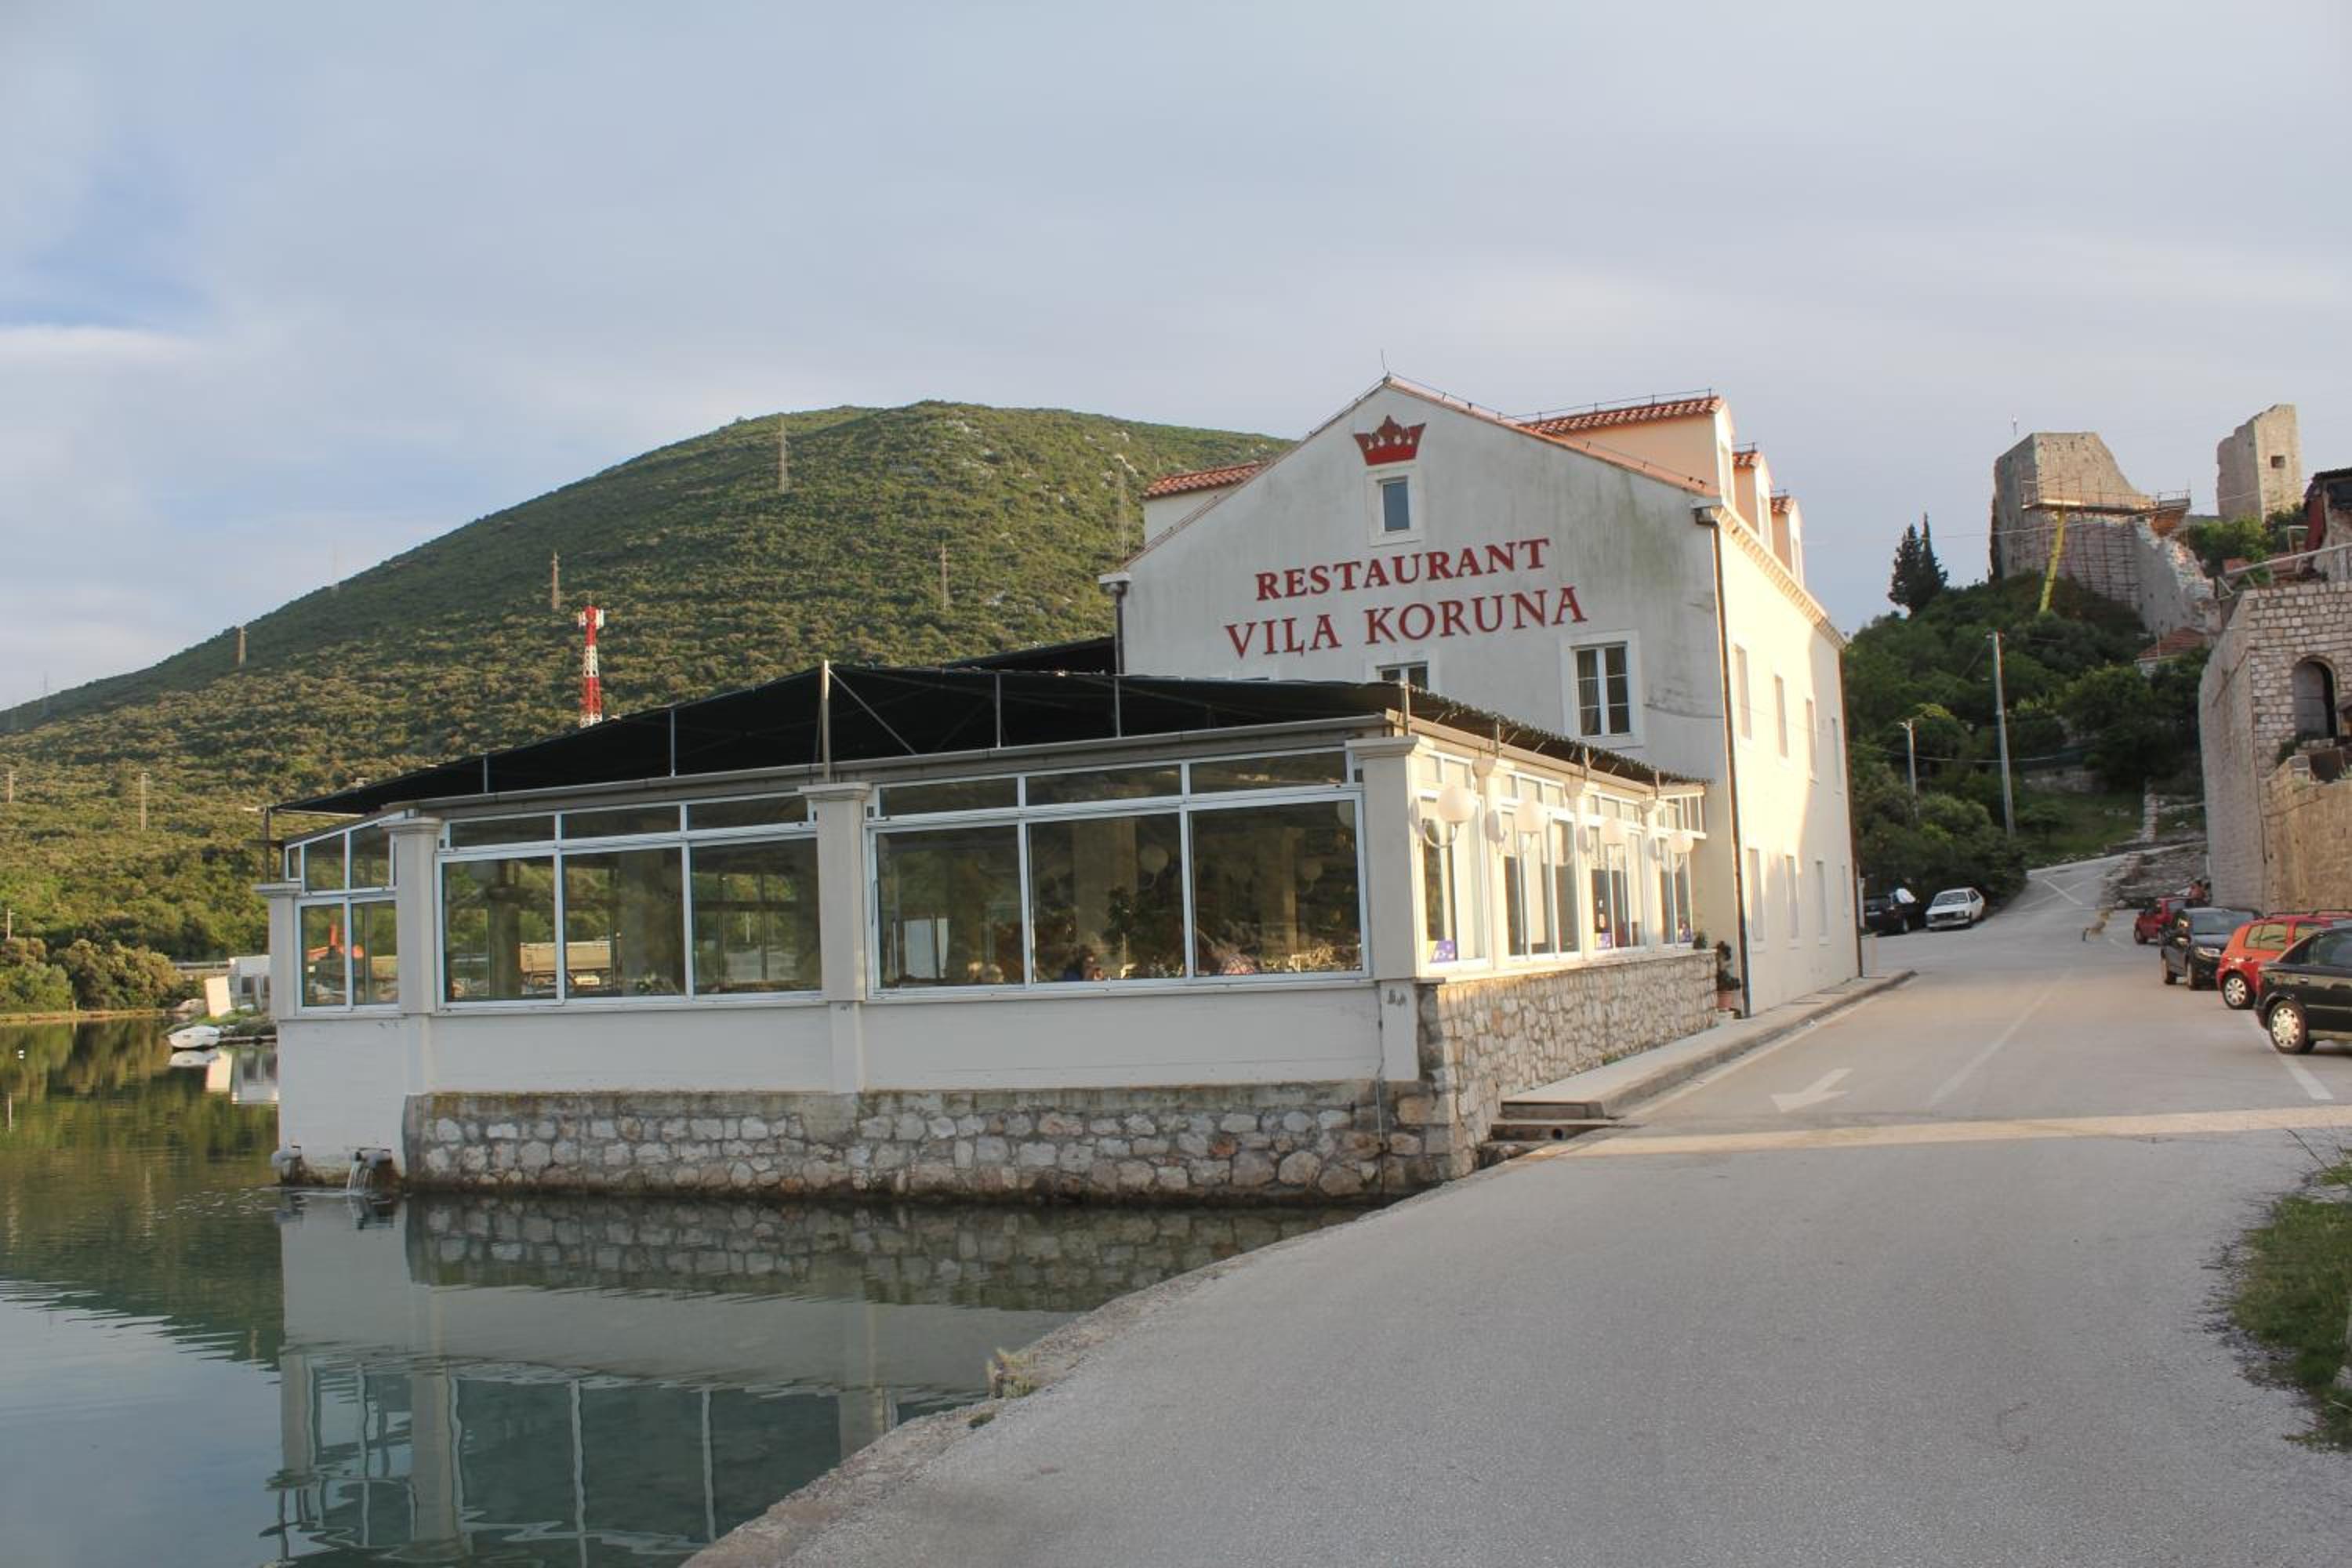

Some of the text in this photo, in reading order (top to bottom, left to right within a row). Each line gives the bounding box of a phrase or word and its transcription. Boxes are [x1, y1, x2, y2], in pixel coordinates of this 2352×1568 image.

[1255, 538, 1550, 602] RESTAURANT
[1225, 586, 1588, 659] VILA KORUNA
